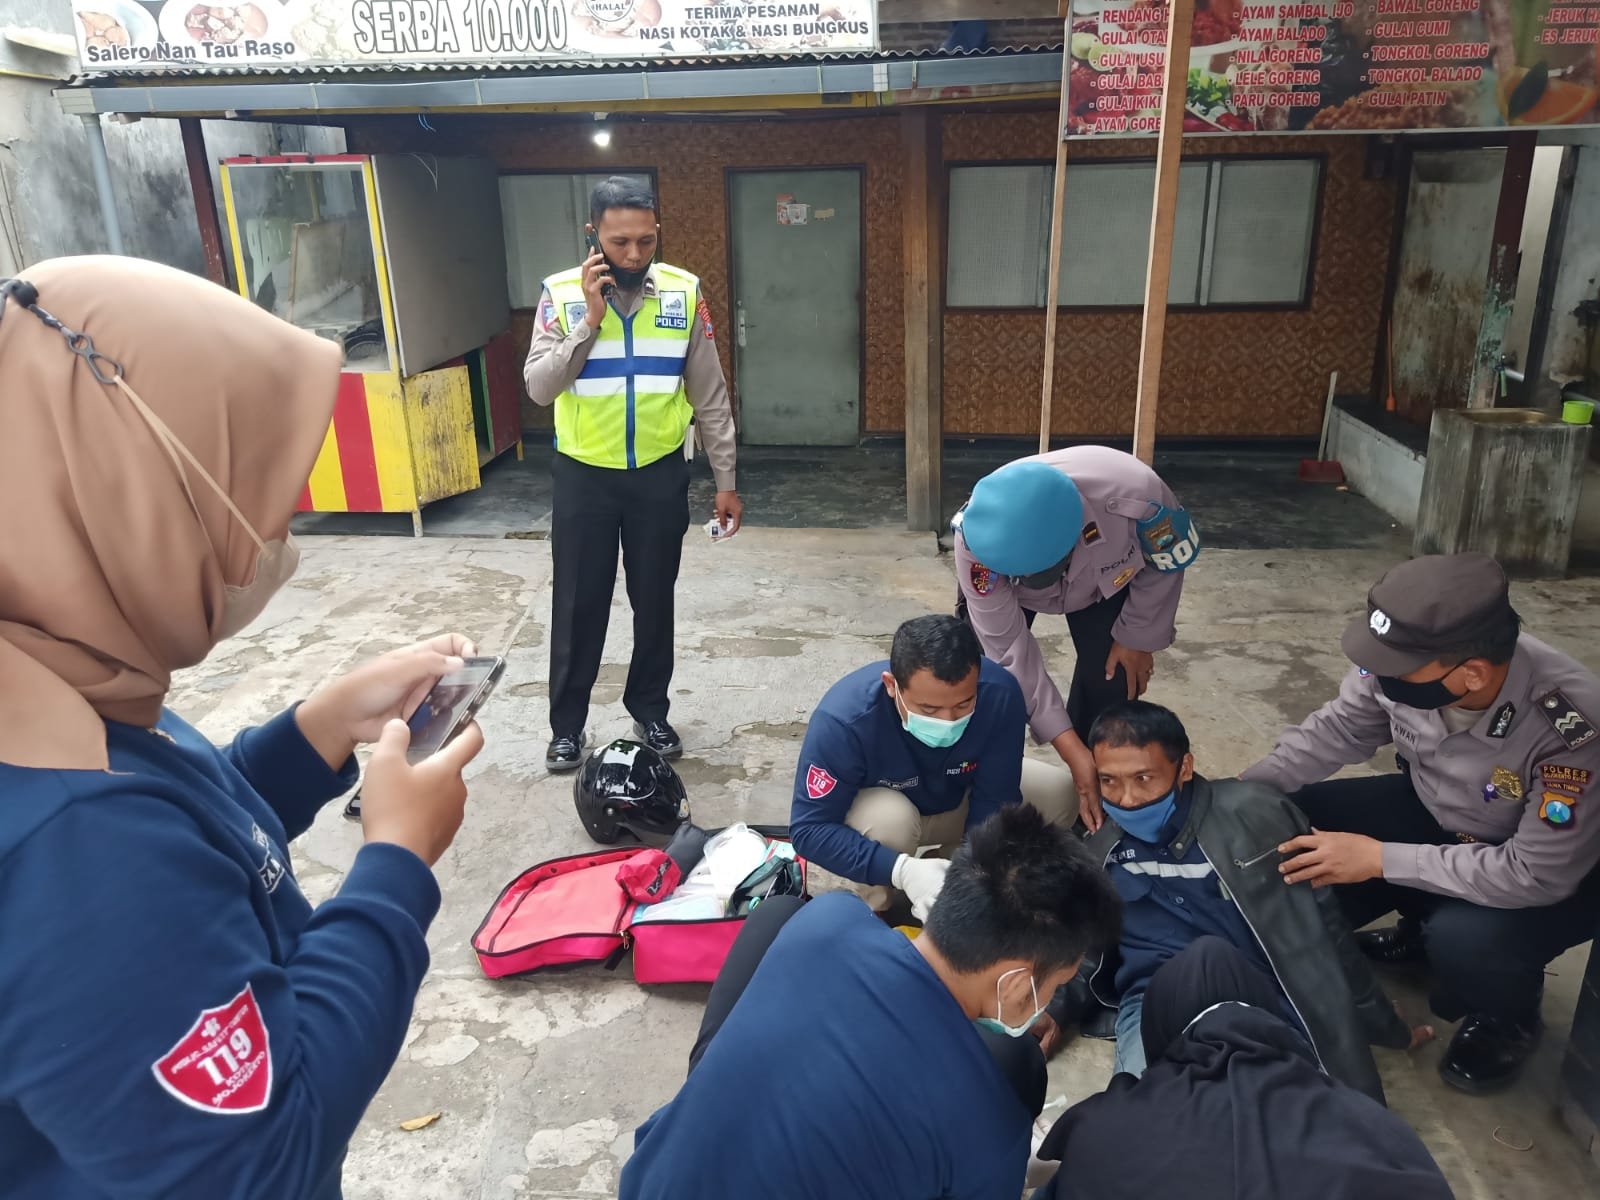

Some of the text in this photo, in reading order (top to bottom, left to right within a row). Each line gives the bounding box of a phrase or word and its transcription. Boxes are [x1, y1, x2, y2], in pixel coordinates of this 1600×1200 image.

[595, 3, 626, 11] HALAL
[685, 3, 820, 20] TERIMA PESANAN
[1241, 2, 1354, 20] AYAM SAMBAL IJO
[1376, 0, 1480, 13] BAWAL GORENG
[1102, 8, 1161, 23] RENDANG
[1545, 8, 1586, 23] JERUK
[352, 0, 567, 53] SERBA 10.000
[640, 20, 869, 40] NASI KOTAK & NASI BUNGKUS
[1239, 25, 1327, 41] AYAM BALADO
[1374, 20, 1450, 38] GULAI CUMI
[1101, 31, 1138, 46] GULAI
[1542, 28, 1600, 44] ES JERUK
[87, 40, 296, 62] Salero Nan Tau Raso
[1237, 48, 1322, 64] NILA GORENG
[1371, 43, 1490, 60] TONGKOL GORENG
[1100, 52, 1165, 68] GULAI USU
[1097, 73, 1163, 89] GULAI BAB
[1235, 69, 1321, 86] LELE GORENG
[1368, 66, 1483, 84] TONGKOL BALADO
[1096, 94, 1162, 111] GULAI KIKI
[1233, 91, 1321, 107] PARU GORENG
[1369, 90, 1447, 107] GULAI PATIN
[1095, 116, 1161, 132] AYAM GORE
[656, 317, 687, 329] POLISI
[1543, 766, 1588, 778] POLRES
[812, 775, 827, 790] 119
[196, 1027, 252, 1085] 119
